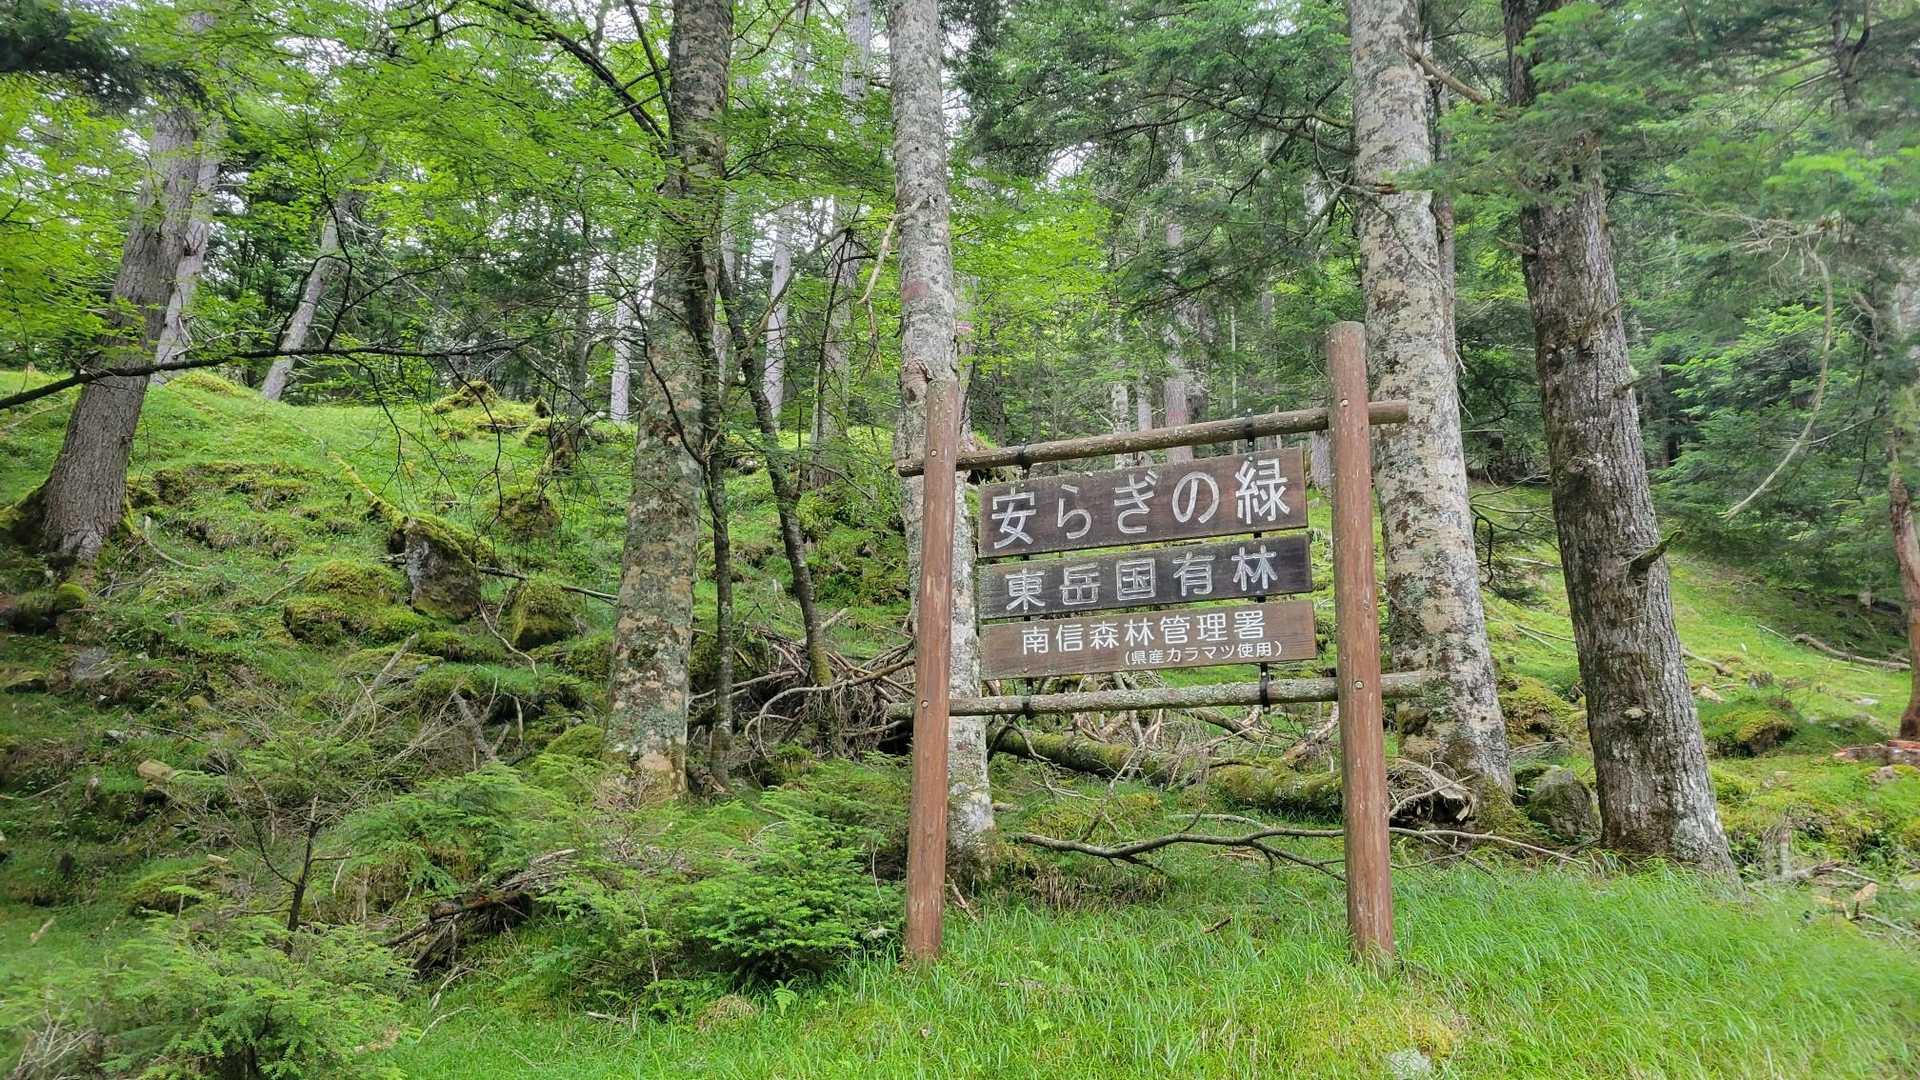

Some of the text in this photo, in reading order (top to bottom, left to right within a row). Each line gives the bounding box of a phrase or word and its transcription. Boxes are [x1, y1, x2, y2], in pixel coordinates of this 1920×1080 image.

[991, 458, 1291, 549] 安らぎの緑
[1005, 545, 1279, 612] 東岳国有林
[1022, 609, 1266, 656] 南信森林管理署
